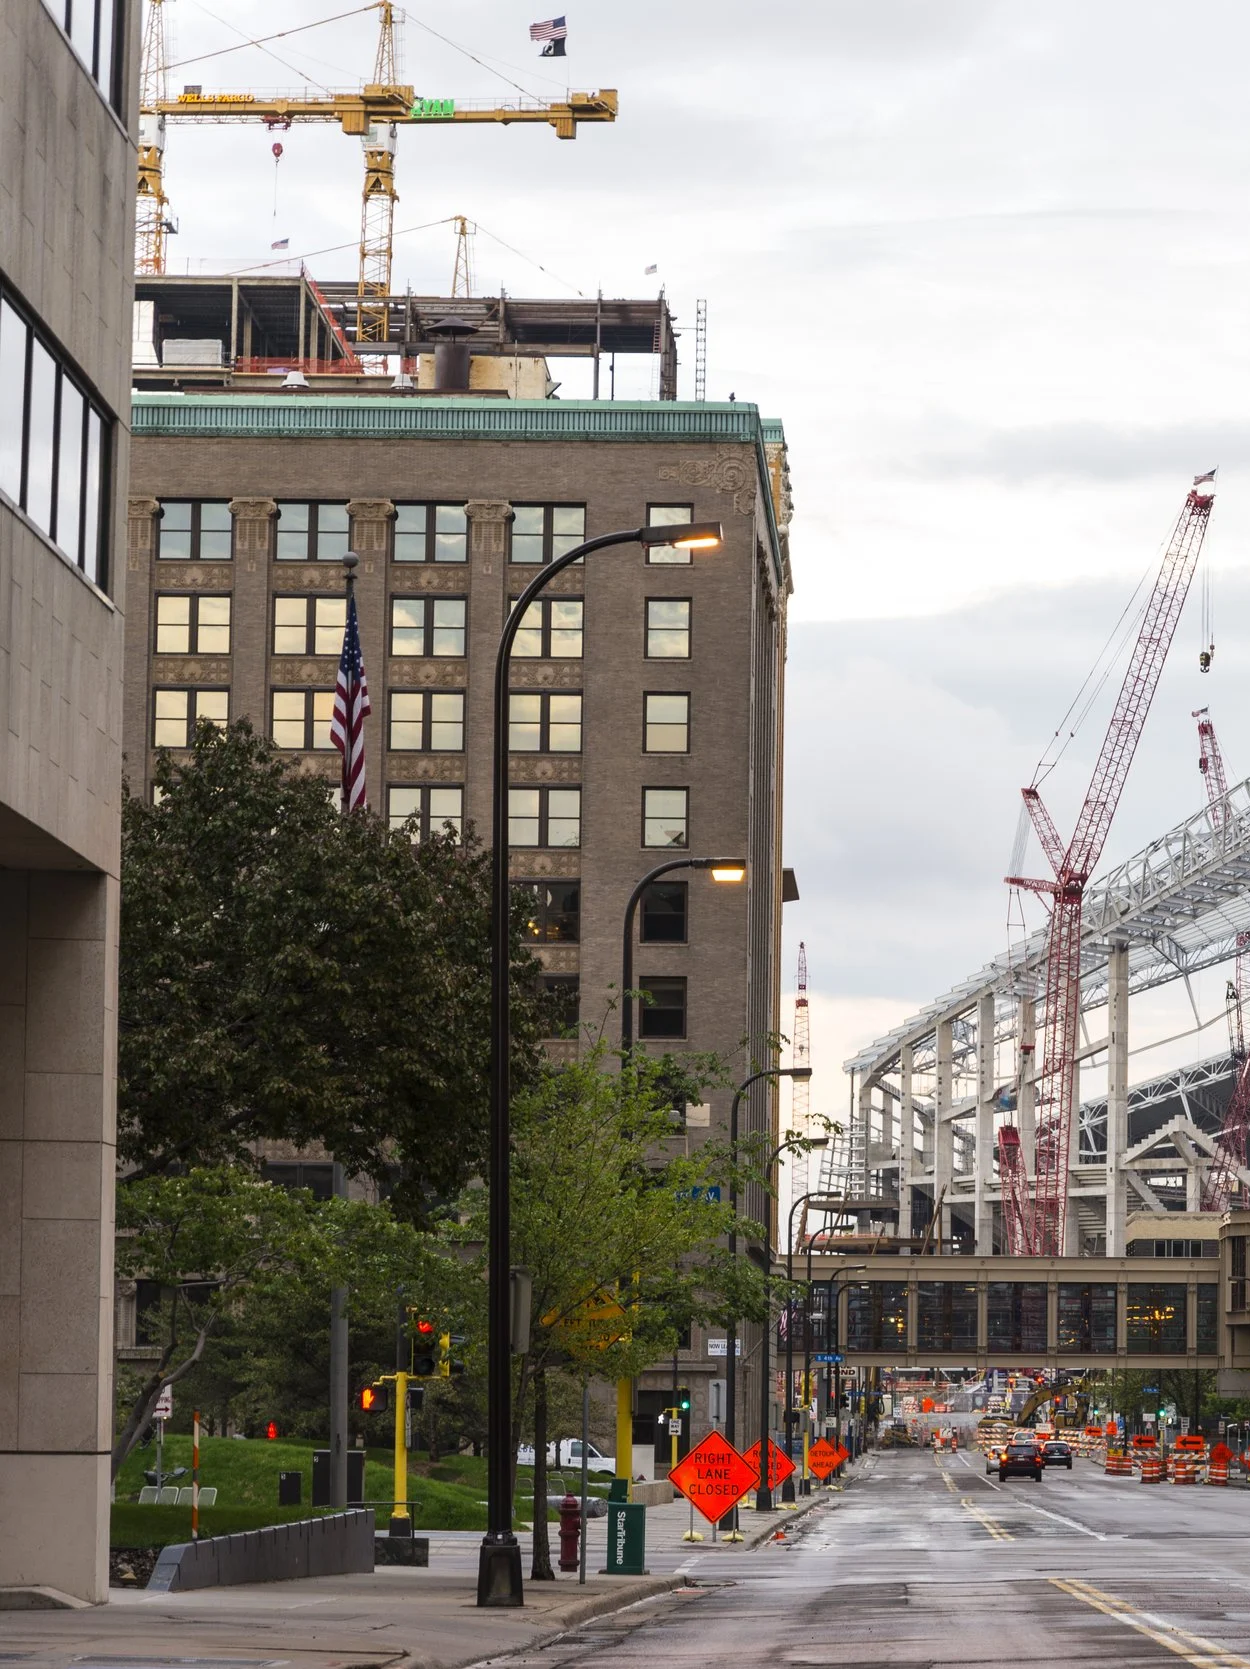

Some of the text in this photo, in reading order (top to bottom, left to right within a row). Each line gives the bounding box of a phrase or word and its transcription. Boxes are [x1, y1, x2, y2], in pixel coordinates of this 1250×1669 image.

[178, 94, 254, 103] WELLS FARGO
[694, 1453, 732, 1464] RIGHT
[697, 1469, 730, 1479] LANE
[689, 1484, 739, 1495] CLOSED
[616, 1511, 626, 1565] StarTribune
